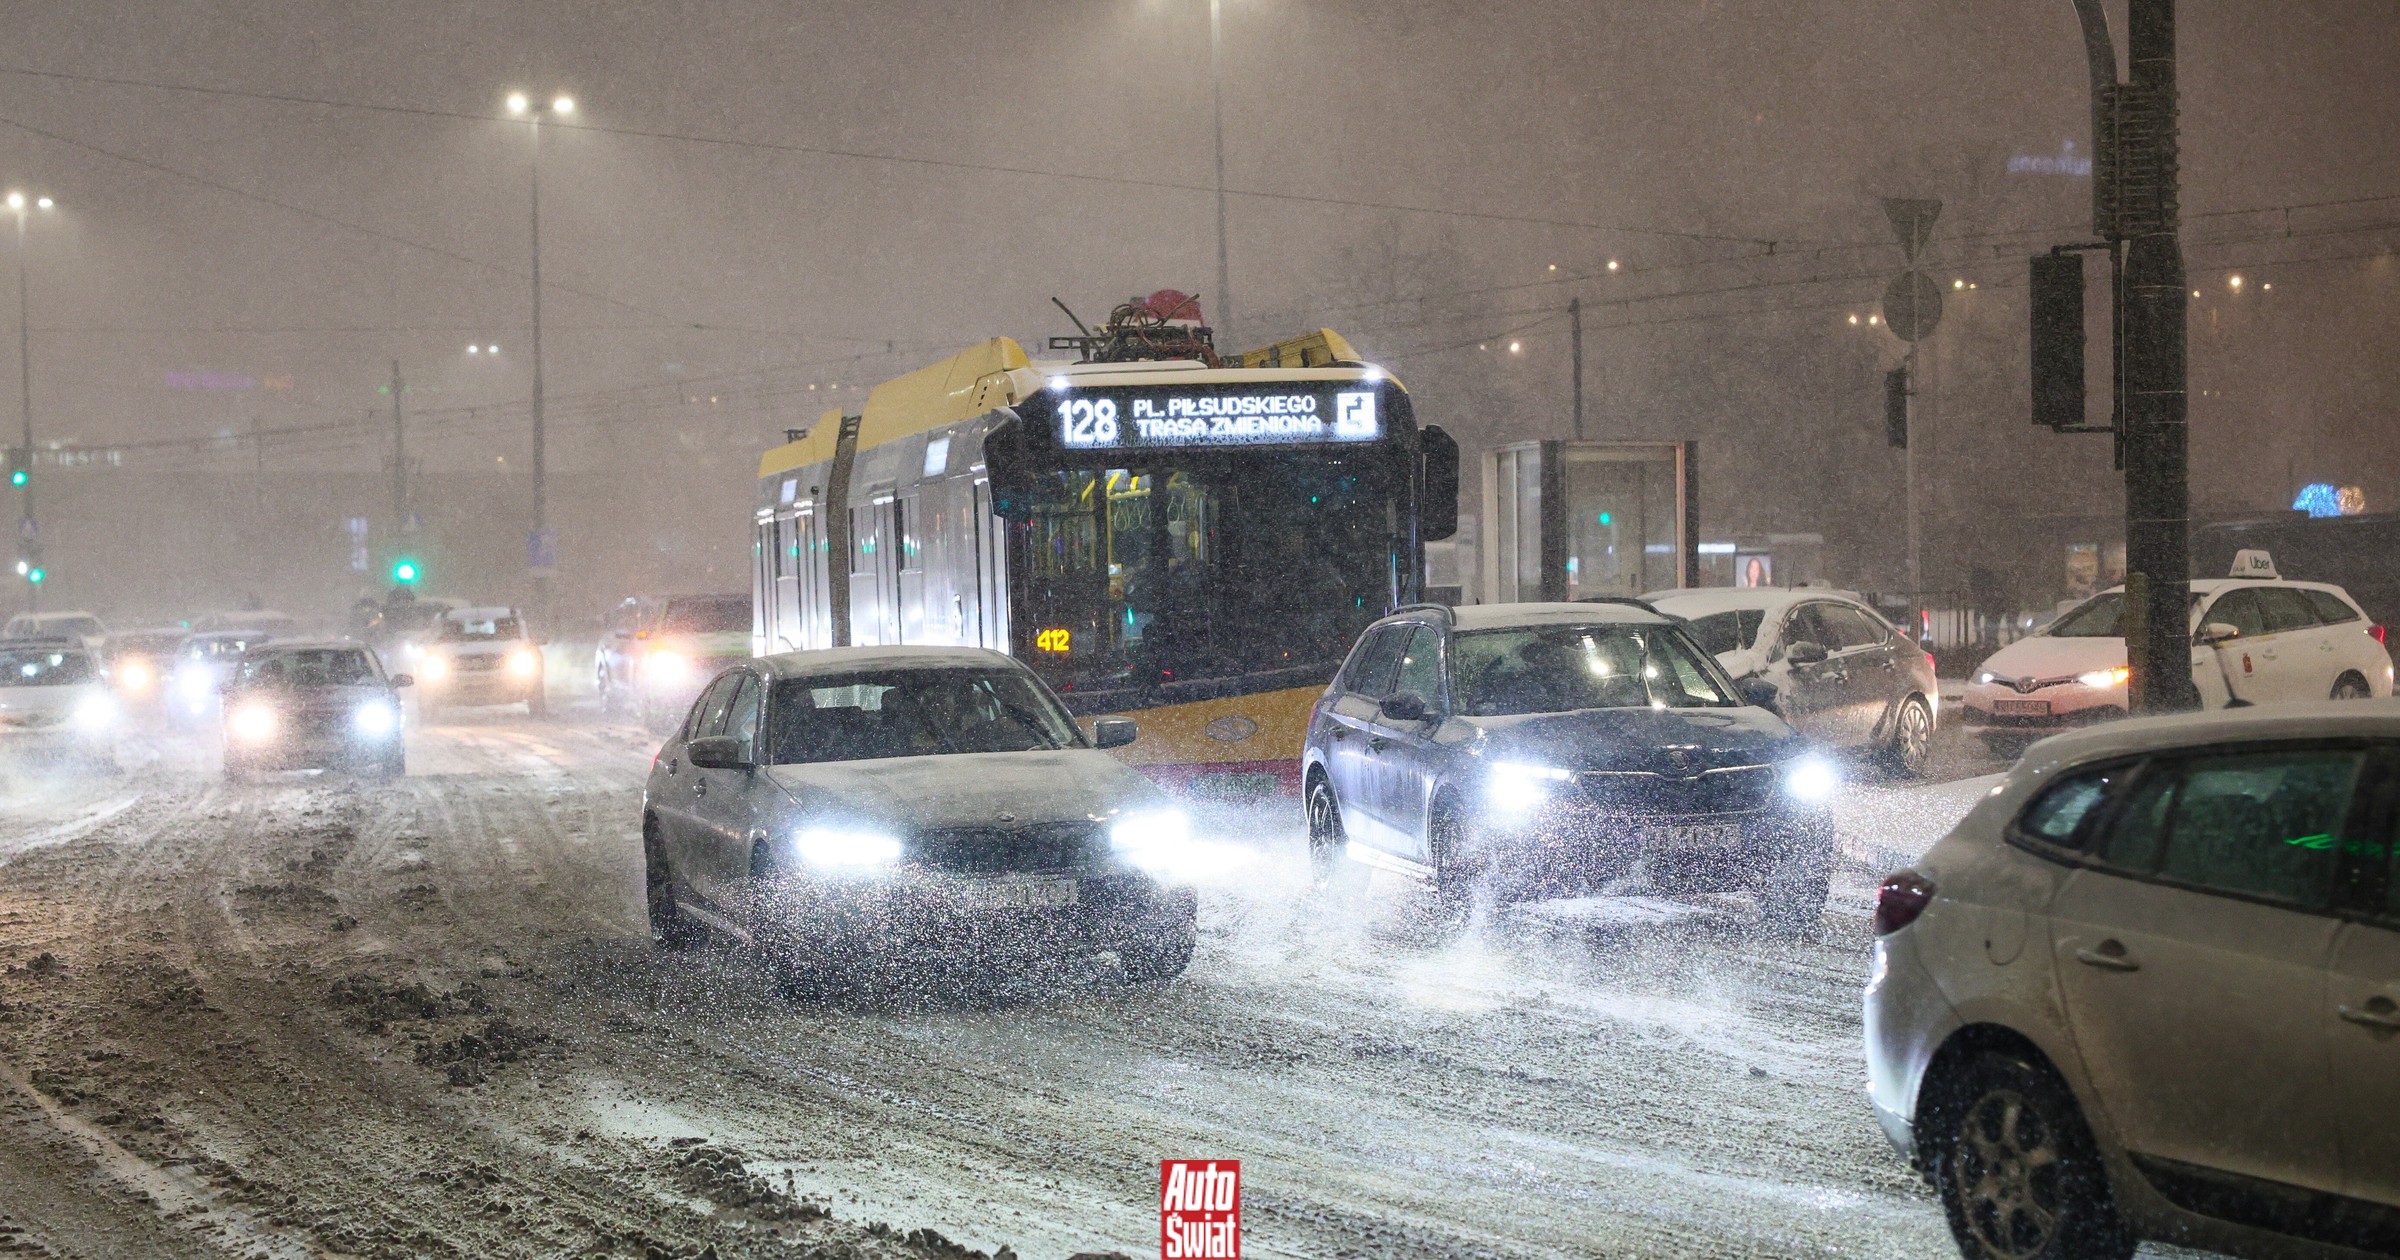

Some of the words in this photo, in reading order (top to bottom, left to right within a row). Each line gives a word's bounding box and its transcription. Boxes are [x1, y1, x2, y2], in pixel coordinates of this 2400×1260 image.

[1134, 400, 1165, 418] PL.
[1168, 395, 1316, 417] PIŁSUDSKIEGO
[1057, 399, 1117, 442] 128
[1136, 417, 1210, 437] TRASA
[1210, 413, 1322, 435] ZMIENIONA
[2249, 555, 2270, 570] Uber
[1037, 629, 1070, 652] 412
